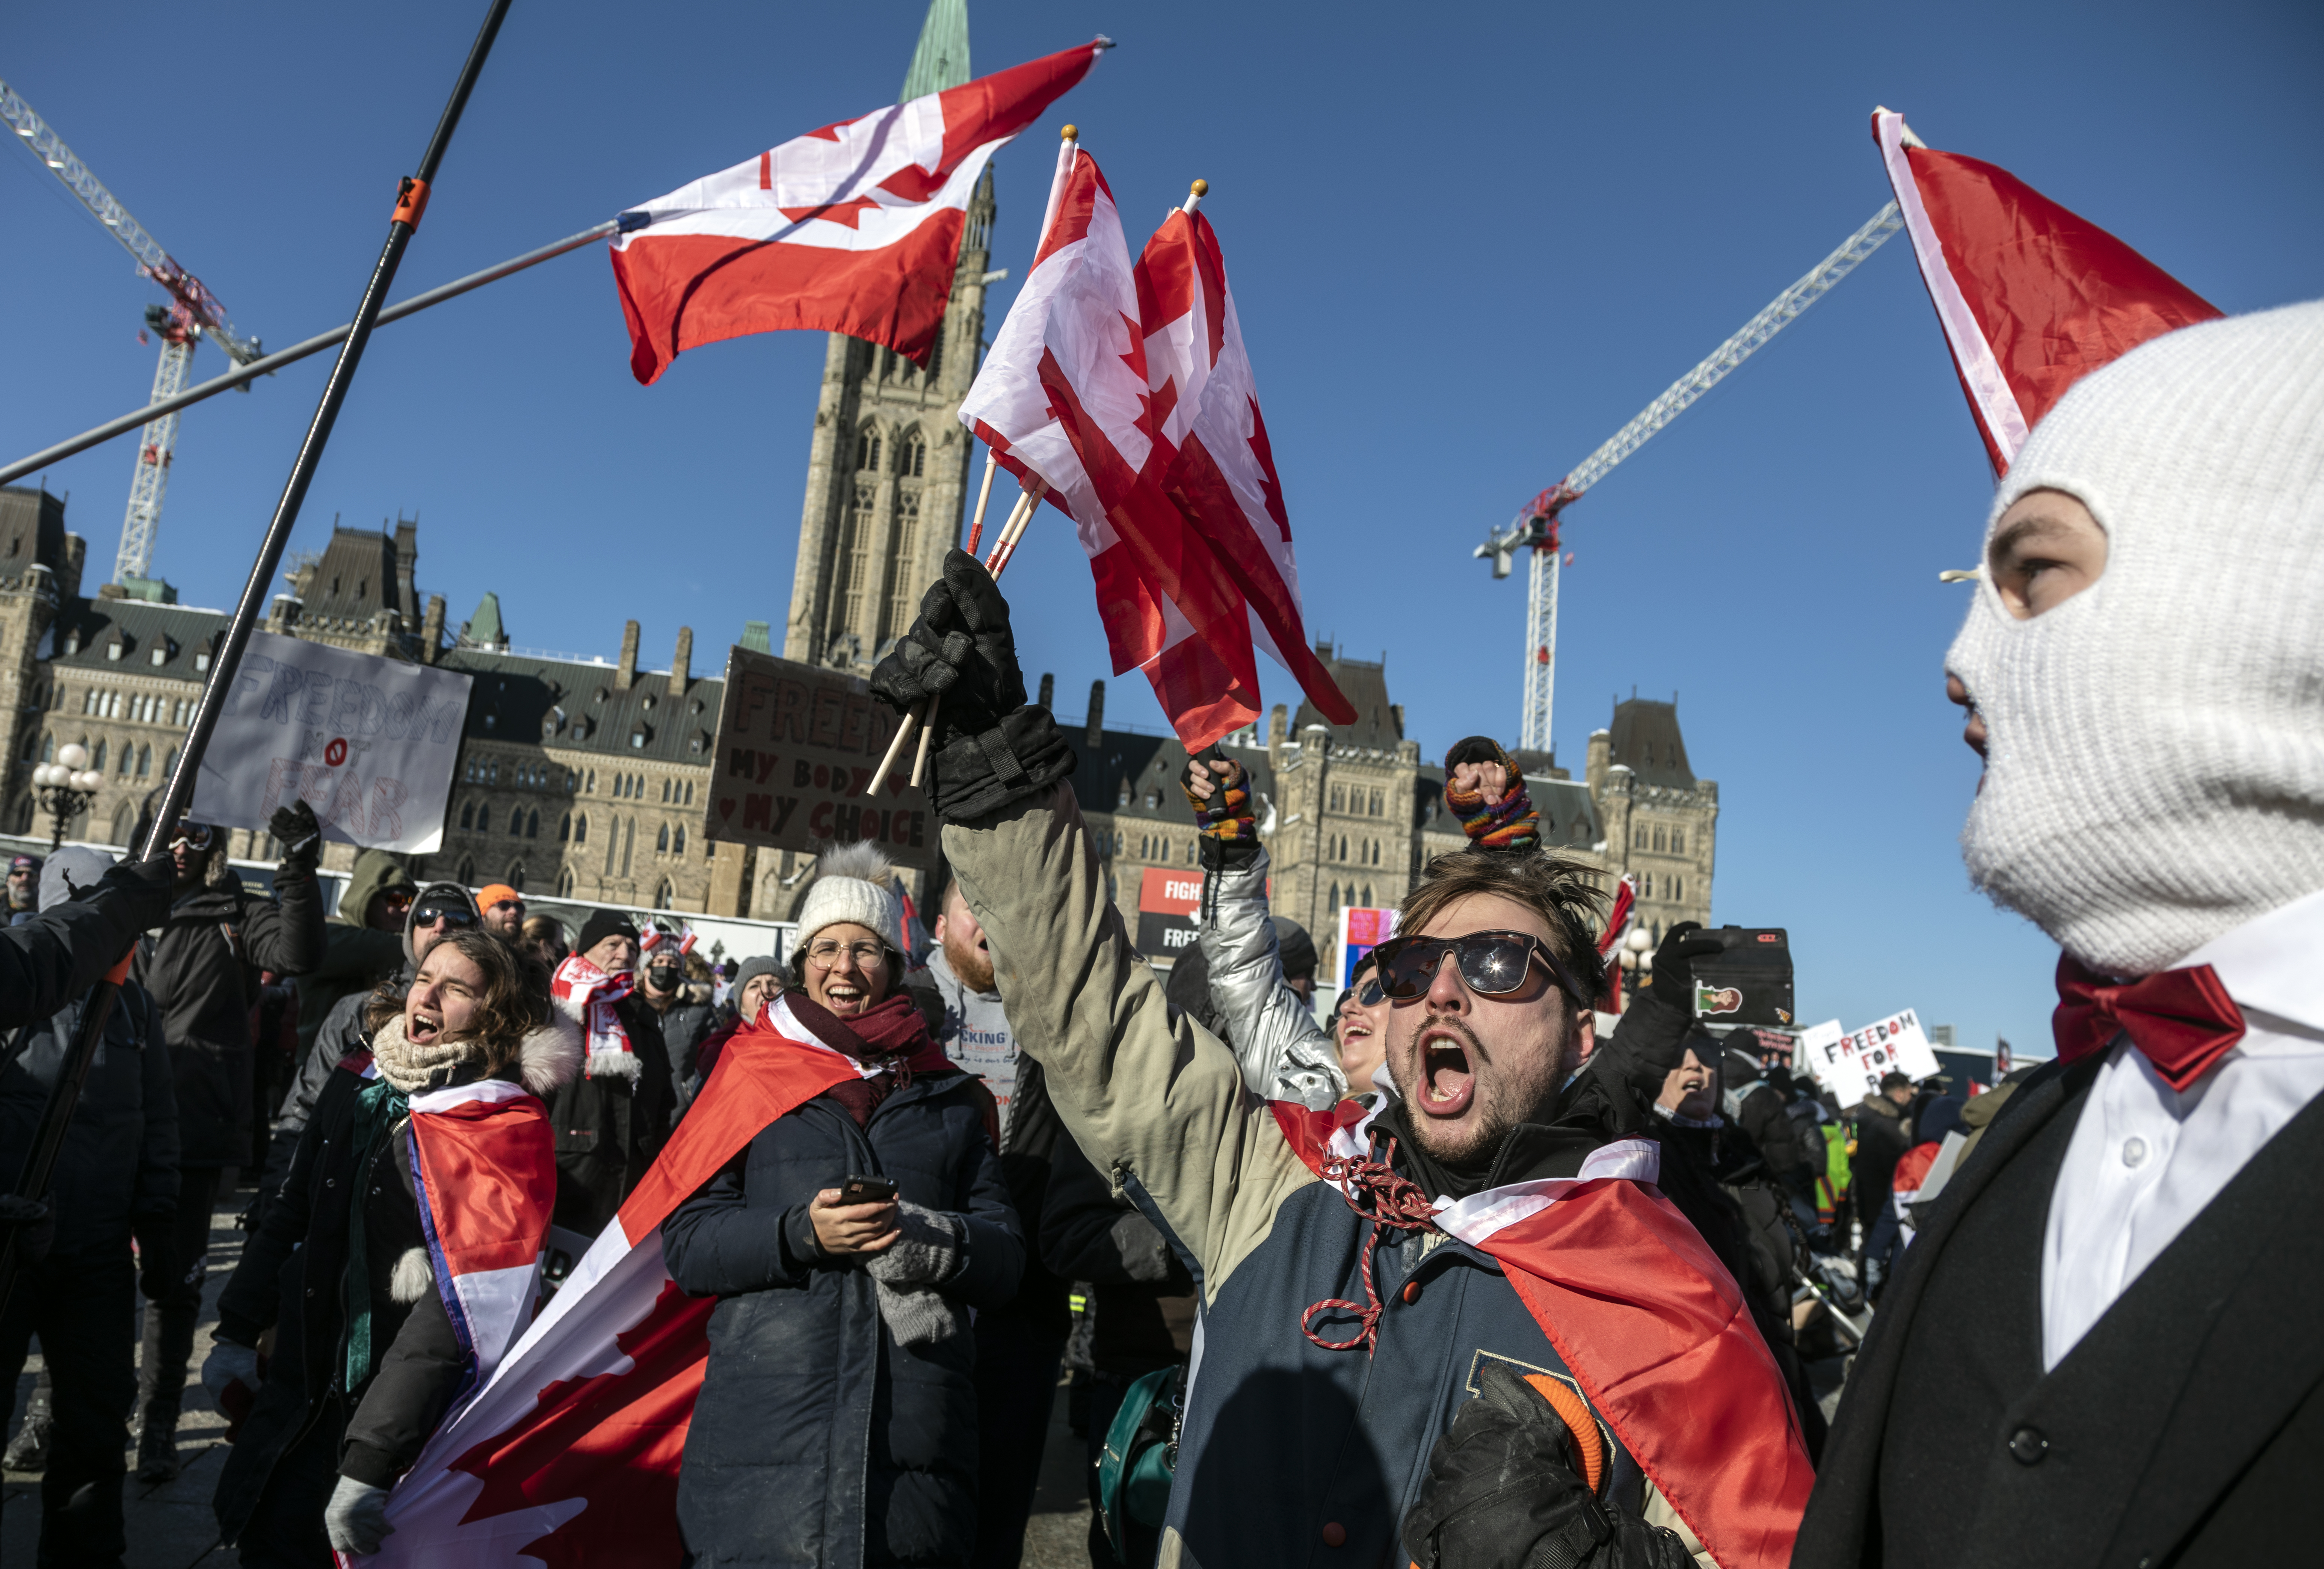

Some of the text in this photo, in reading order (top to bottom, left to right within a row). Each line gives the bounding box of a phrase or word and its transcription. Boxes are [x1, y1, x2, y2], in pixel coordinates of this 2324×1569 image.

[221, 653, 461, 744] FREEDOM
[734, 670, 919, 760] FREED
[300, 729, 371, 767] NOT
[729, 748, 872, 797] MY BODY
[259, 757, 409, 841] FEAR
[742, 793, 924, 848] MY CHOICE
[1165, 880, 1202, 901] FIGH
[1824, 1013, 1914, 1065] FREEDOM
[1862, 1043, 1899, 1071] FOR
